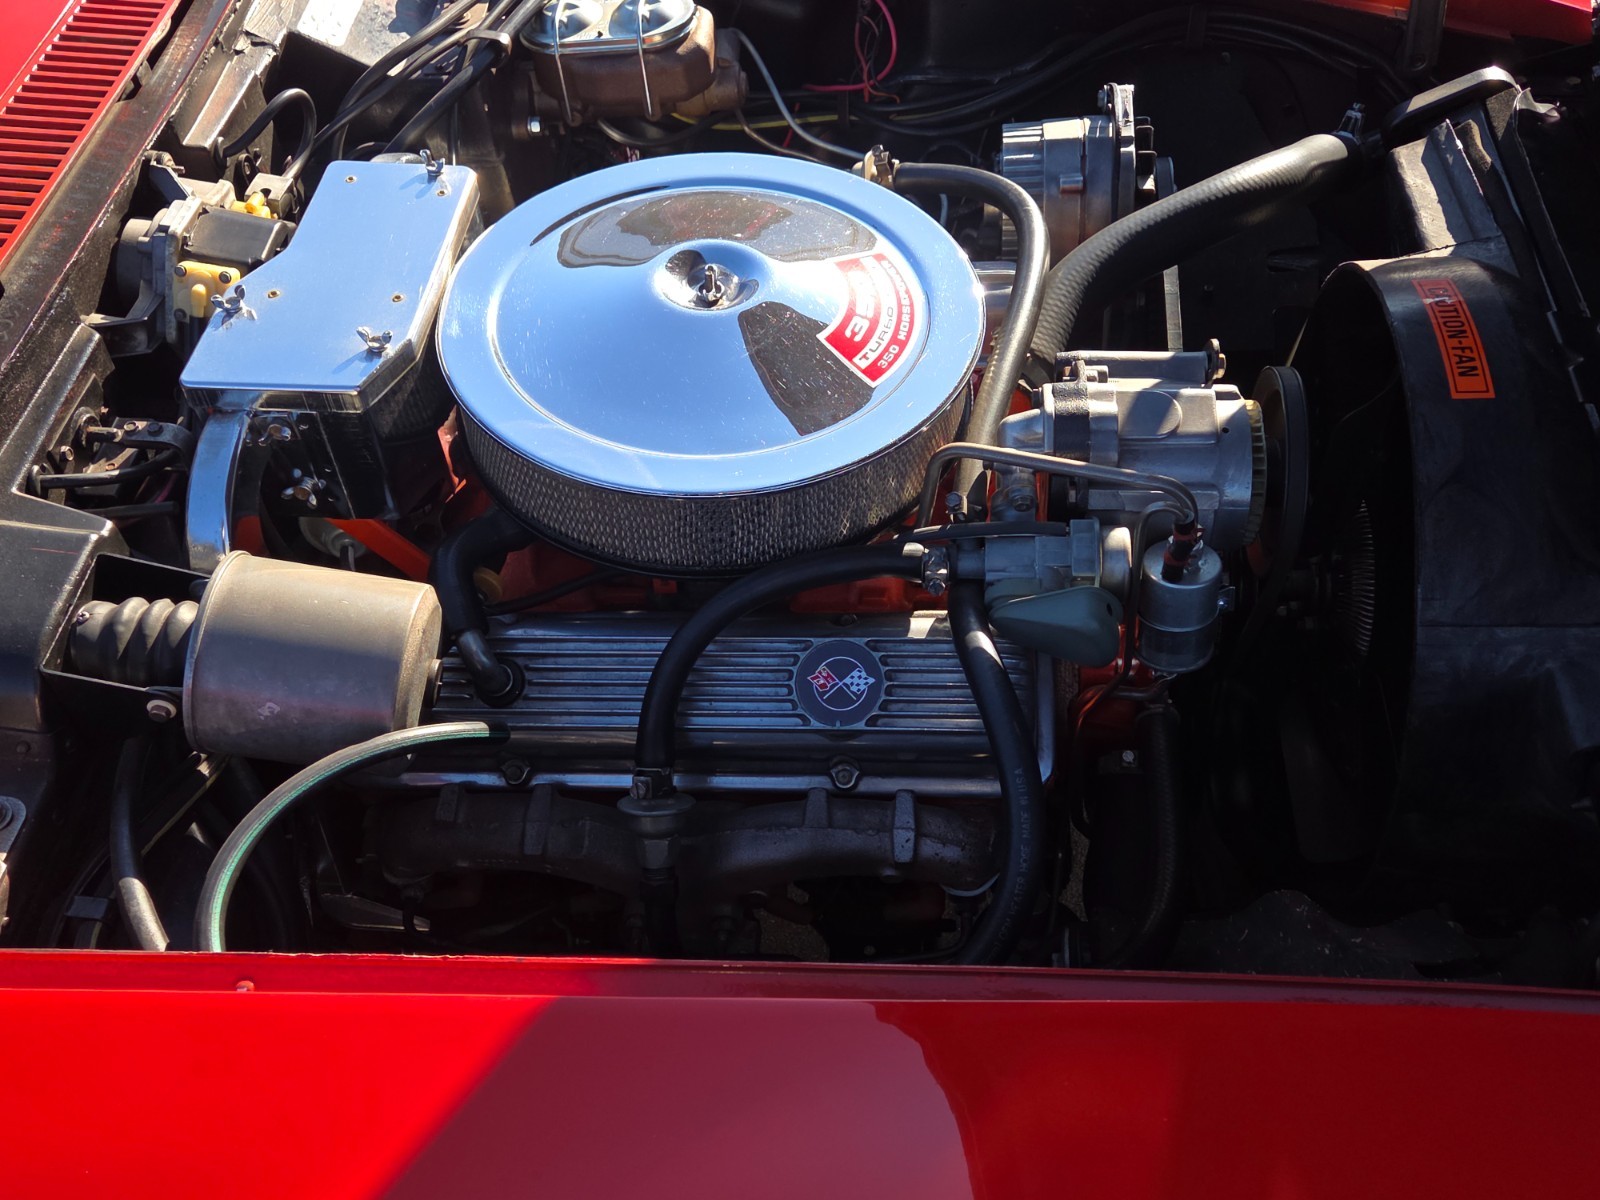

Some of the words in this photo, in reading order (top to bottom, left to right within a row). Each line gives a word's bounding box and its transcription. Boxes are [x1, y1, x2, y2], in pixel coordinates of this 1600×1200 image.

[877, 344, 900, 369] 350
[1014, 768, 1028, 792] USA
[1020, 810, 1031, 838] MADE
[1019, 844, 1030, 873] HOSE
